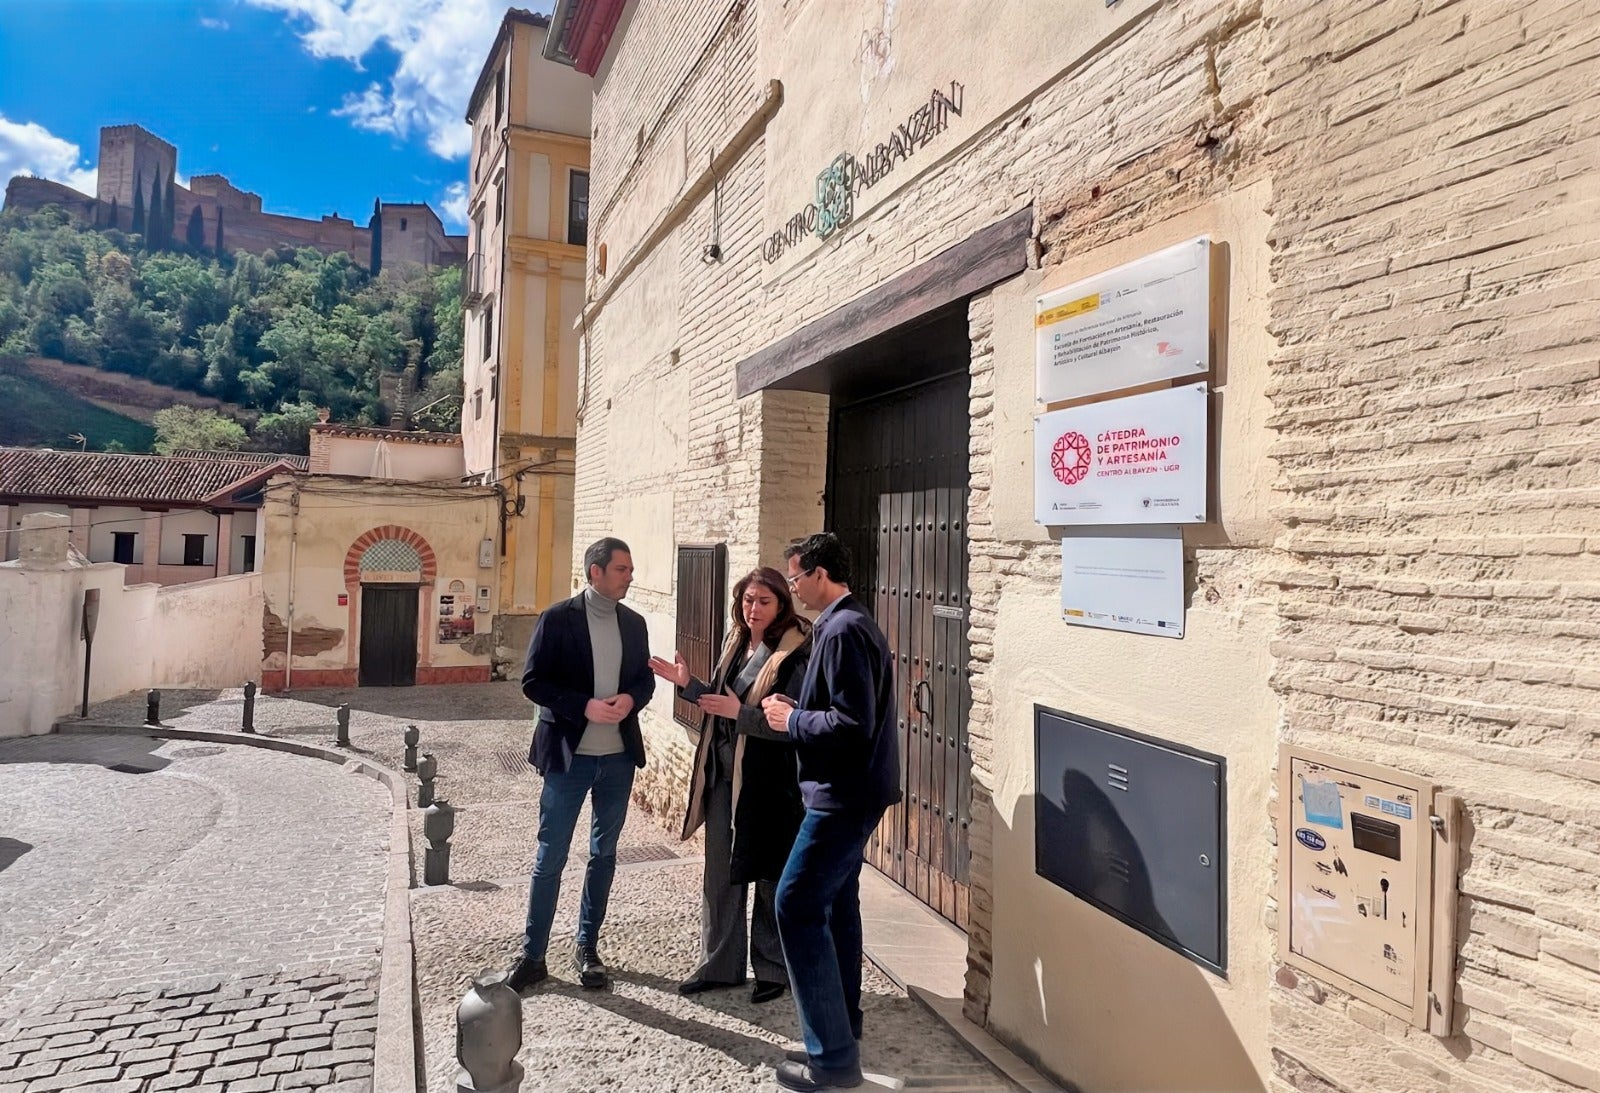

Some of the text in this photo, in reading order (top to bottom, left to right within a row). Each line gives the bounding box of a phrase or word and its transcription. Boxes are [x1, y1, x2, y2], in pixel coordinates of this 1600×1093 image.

[762, 203, 818, 264] CENTRO
[1143, 308, 1184, 326] Restauración
[1097, 428, 1146, 443] CÁTEDRA
[1097, 436, 1180, 455] DE PATRIMONIO
[1097, 449, 1167, 466] Y ARTESANÍA
[1096, 469, 1123, 478] CENTRO
[1163, 464, 1180, 473] UGR
